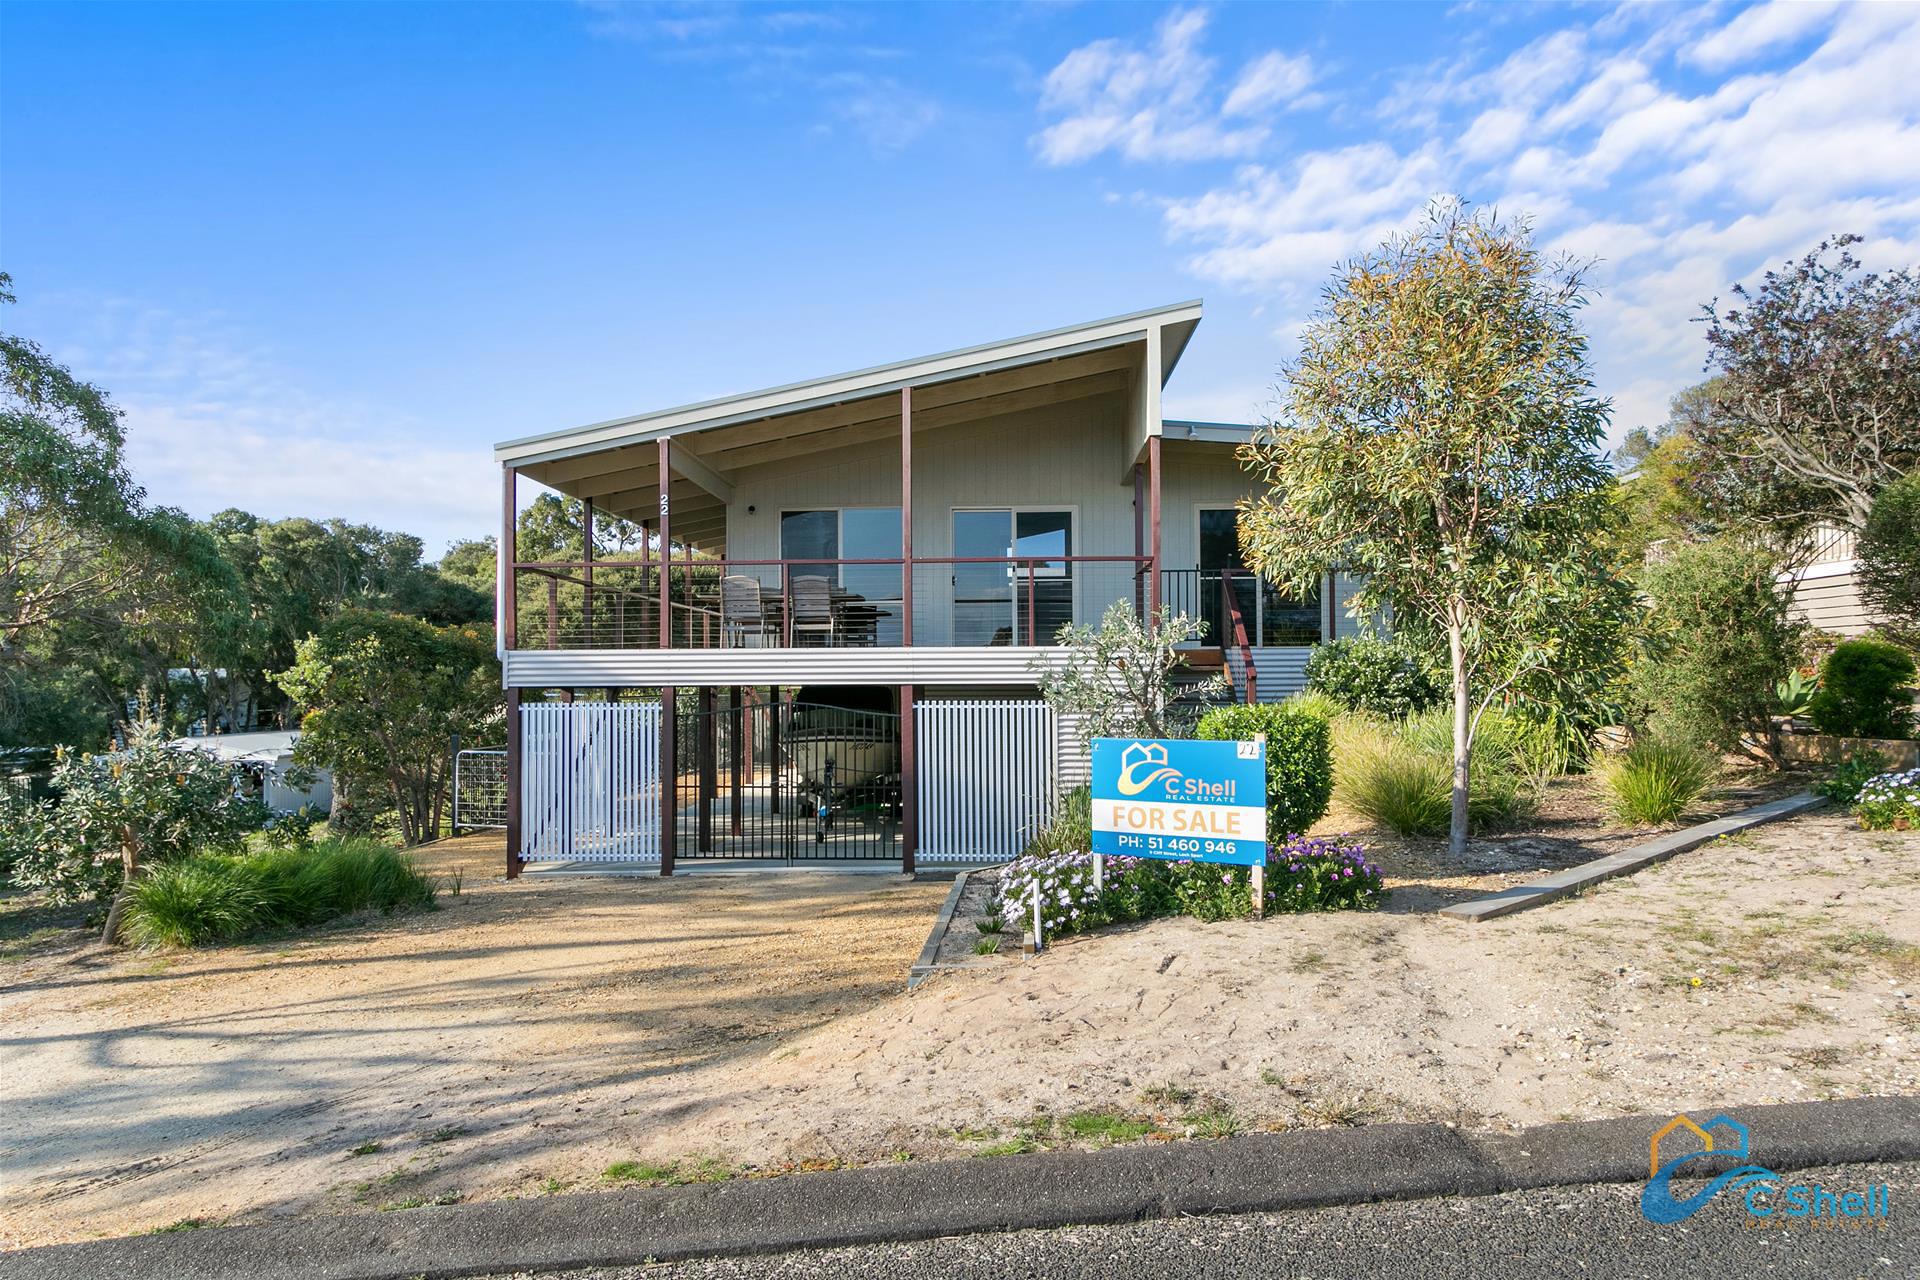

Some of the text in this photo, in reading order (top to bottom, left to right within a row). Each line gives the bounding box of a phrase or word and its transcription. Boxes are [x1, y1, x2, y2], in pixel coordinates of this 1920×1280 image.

[660, 494, 669, 515] 22
[1165, 778, 1236, 796] C Shell
[1197, 795, 1235, 803] ESTATE
[1113, 806, 1241, 835] FOR SALE
[1118, 835, 1236, 854] PH: 51 460 946
